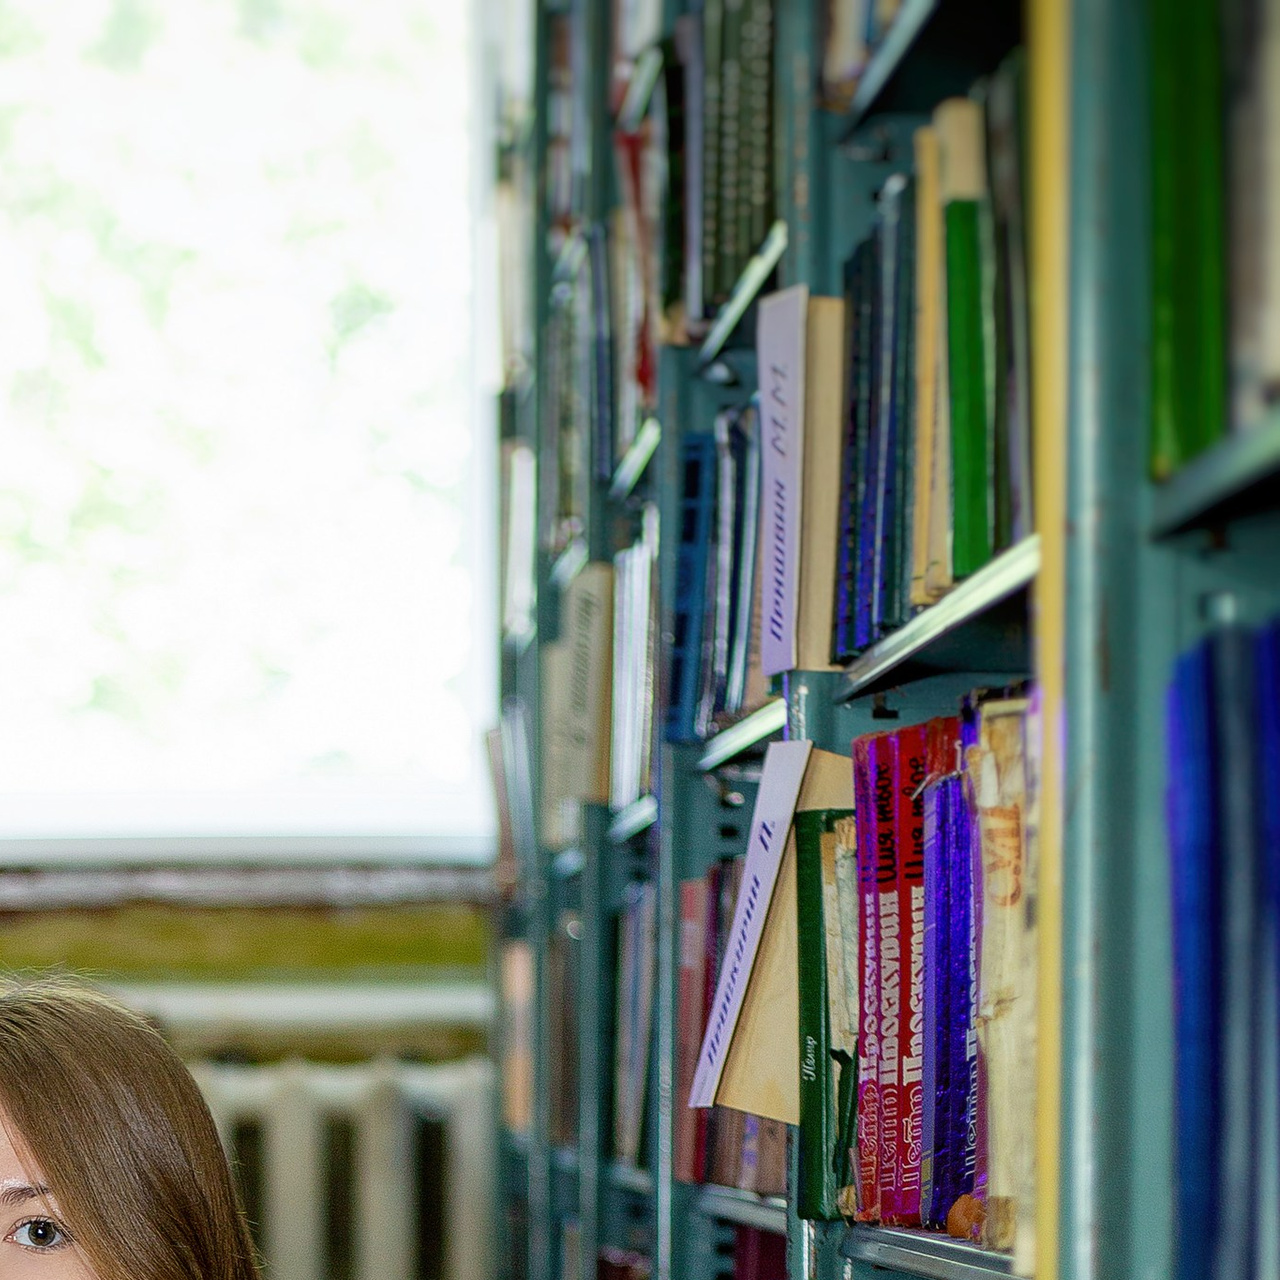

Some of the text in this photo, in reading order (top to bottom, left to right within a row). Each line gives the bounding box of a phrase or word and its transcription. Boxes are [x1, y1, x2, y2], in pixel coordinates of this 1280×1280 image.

[769, 478, 786, 642] Пришвин
[859, 892, 879, 1084] Проскурин
[878, 890, 900, 1086] Проскурин
